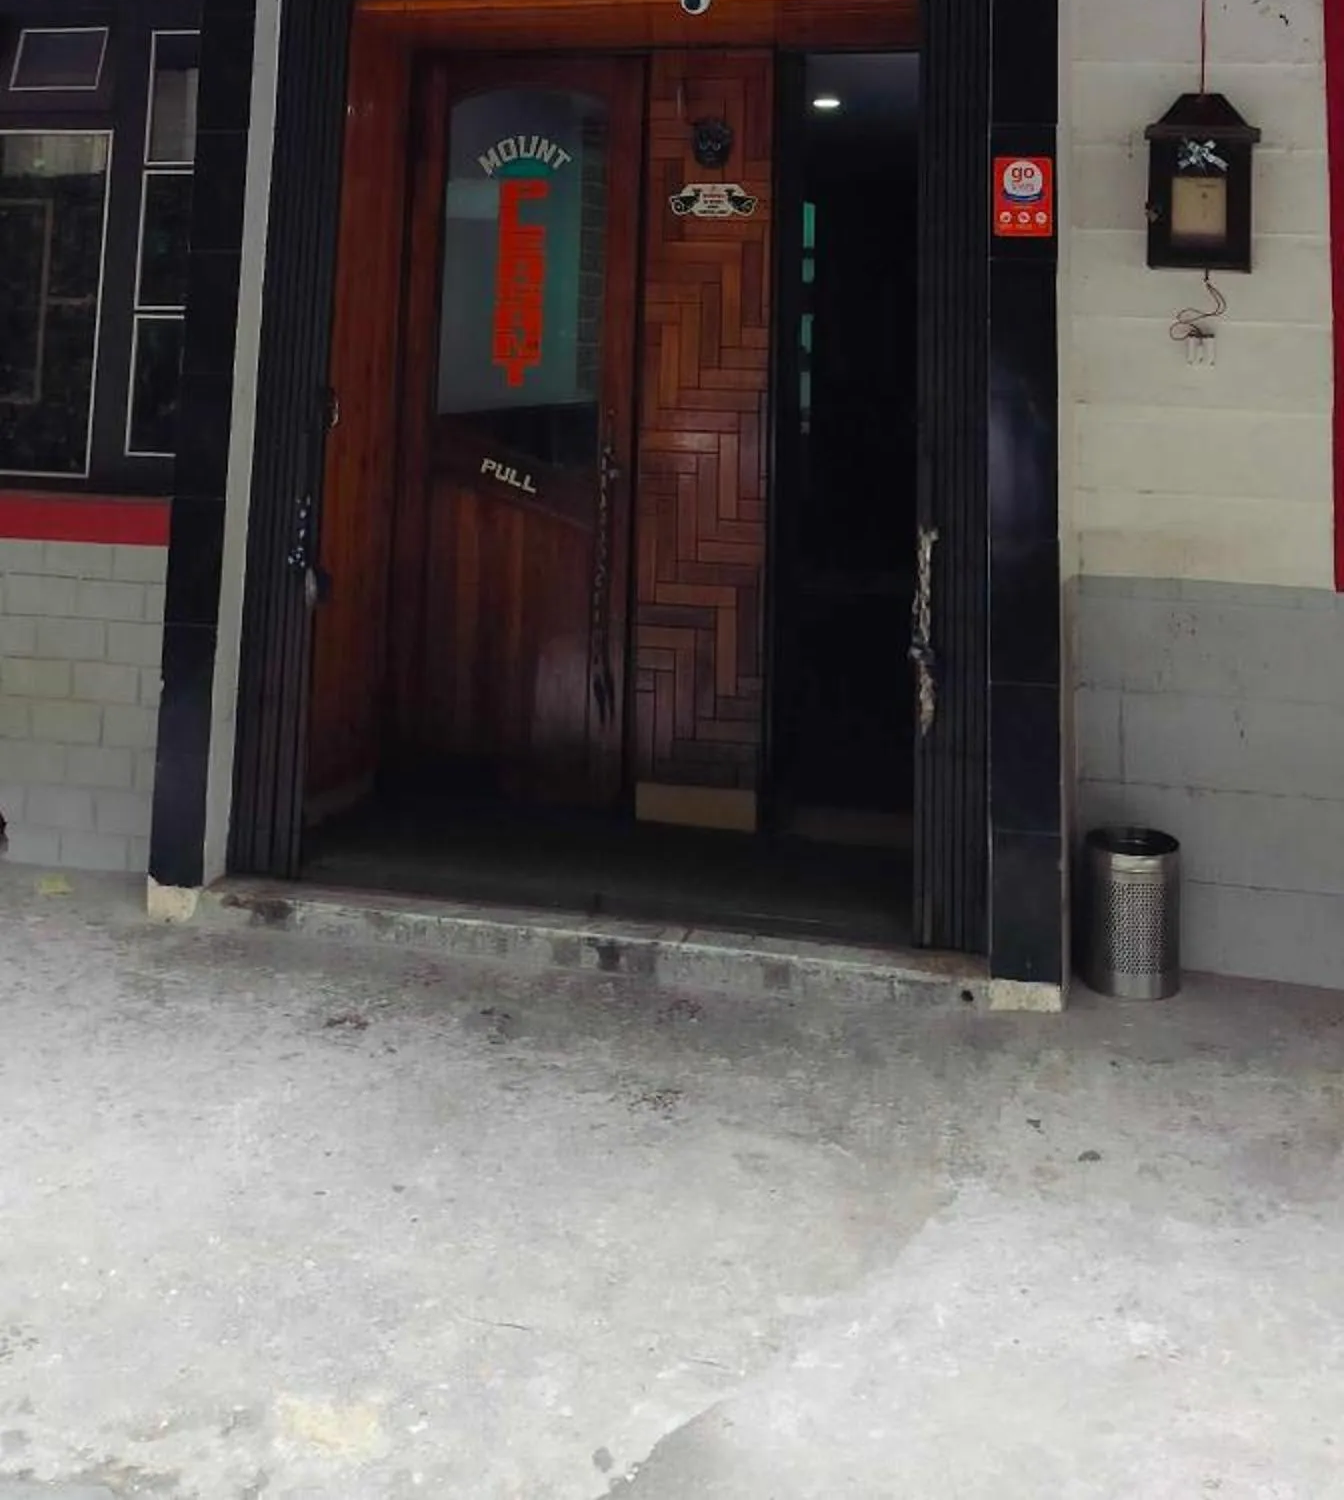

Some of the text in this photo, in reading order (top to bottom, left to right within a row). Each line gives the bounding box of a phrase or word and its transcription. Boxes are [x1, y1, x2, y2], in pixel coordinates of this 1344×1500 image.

[478, 135, 572, 177] MOUNT
[1011, 167, 1034, 182] go
[481, 458, 537, 493] PULL
